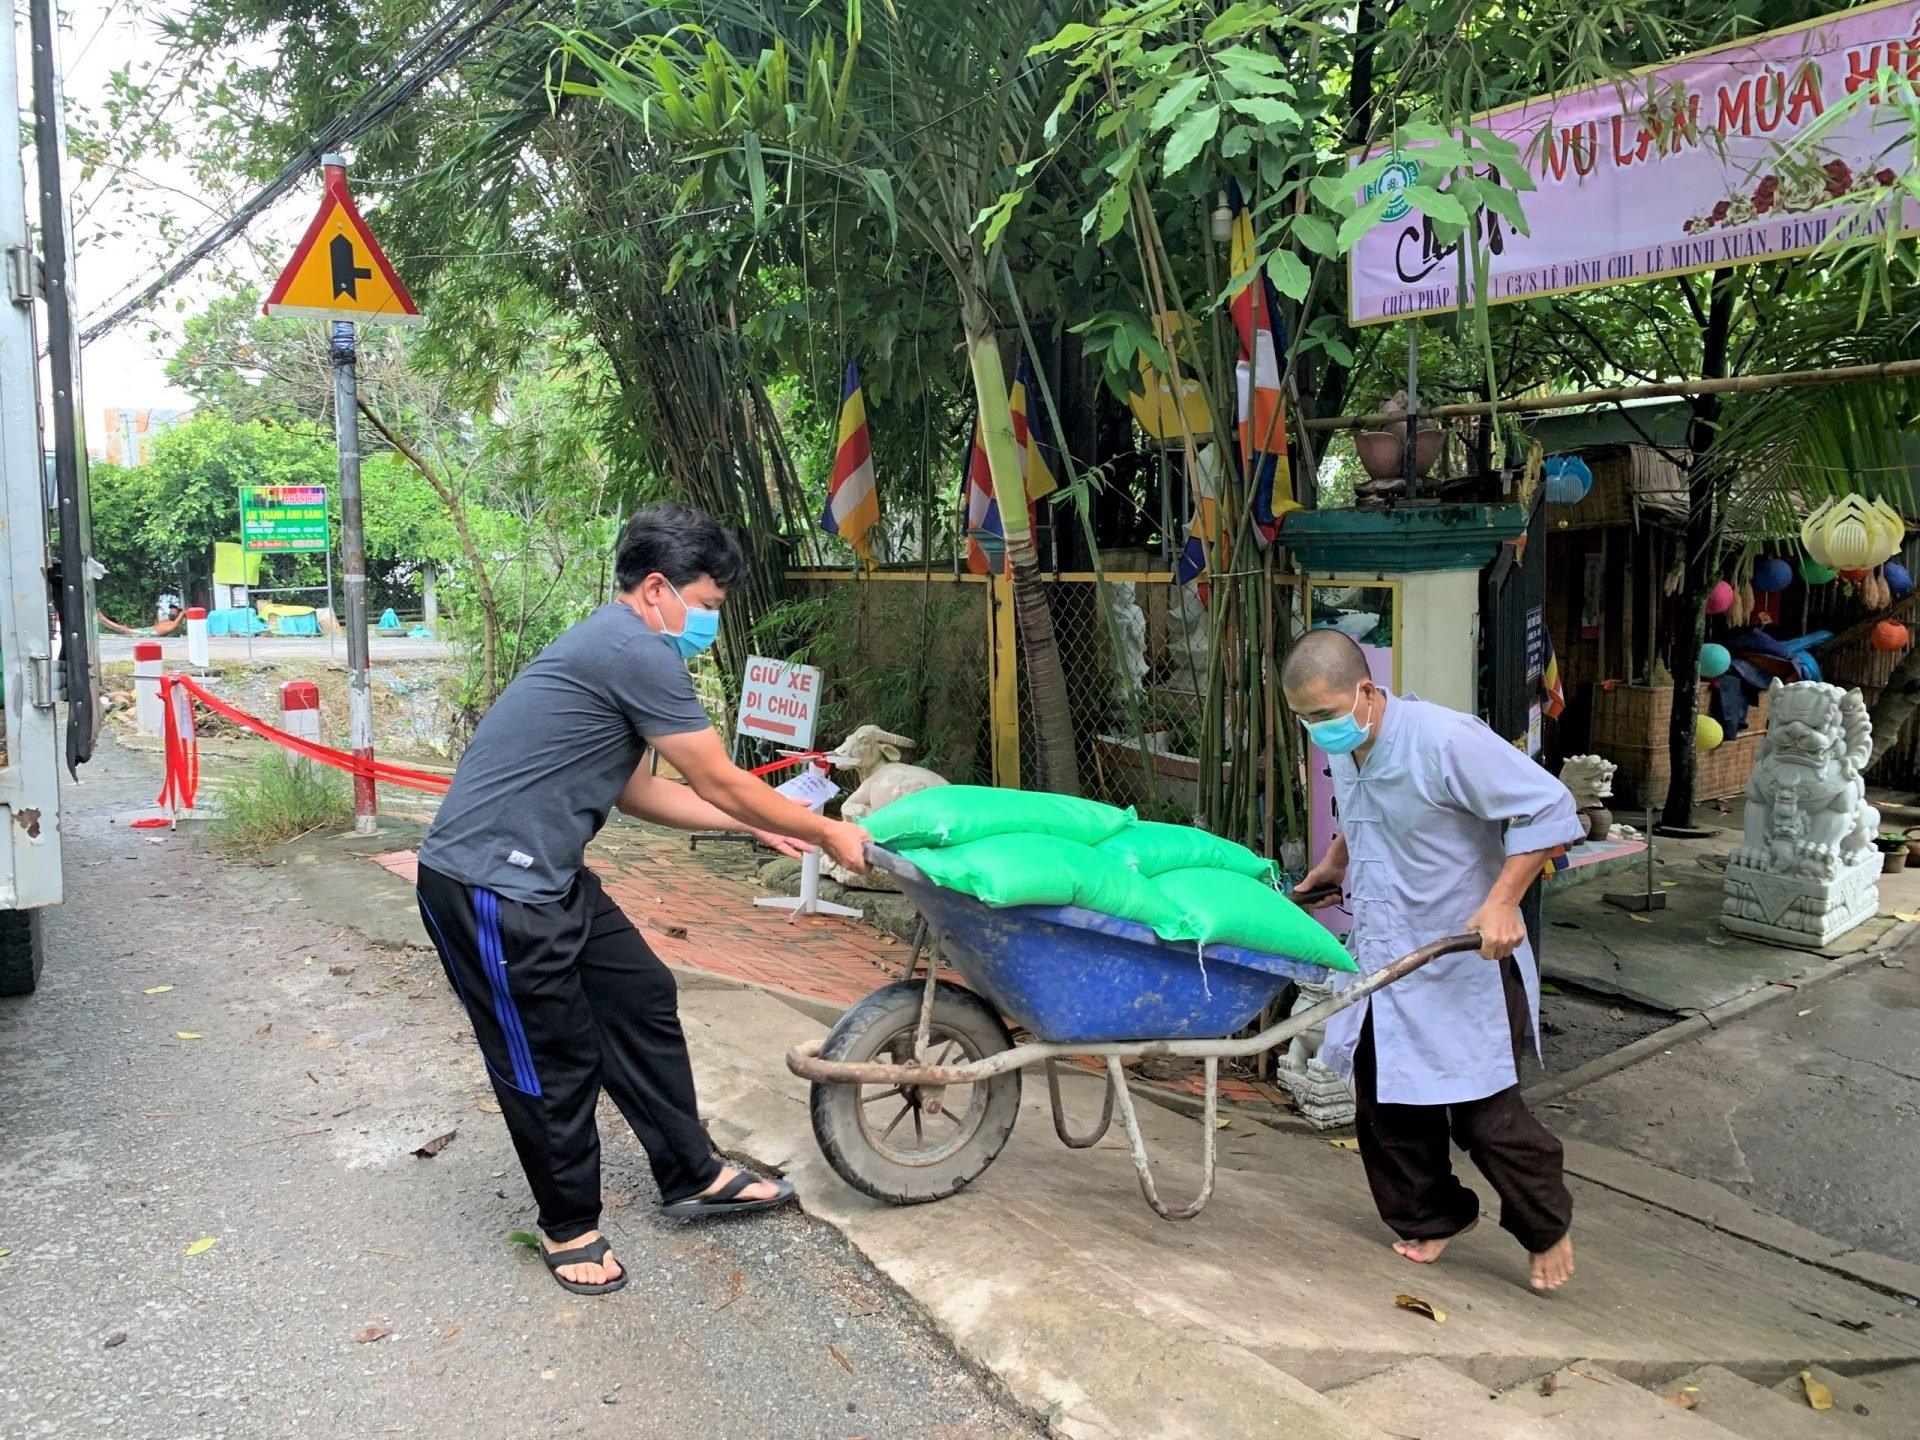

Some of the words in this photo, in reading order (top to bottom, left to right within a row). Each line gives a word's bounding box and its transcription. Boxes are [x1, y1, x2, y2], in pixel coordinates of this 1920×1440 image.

[1718, 62, 1825, 138] MÙA
[1382, 289, 1413, 317] CHÙA
[1418, 284, 1450, 310] PHÁP
[1506, 271, 1537, 297] C3/8
[1542, 264, 1559, 291] LÊ
[1565, 259, 1601, 288] ĐÌNH
[1646, 245, 1664, 274] LÊ
[1671, 239, 1715, 270] MINH
[1781, 218, 1827, 251] BÌNH
[768, 693, 808, 720] CHÙA
[787, 671, 812, 692] XE
